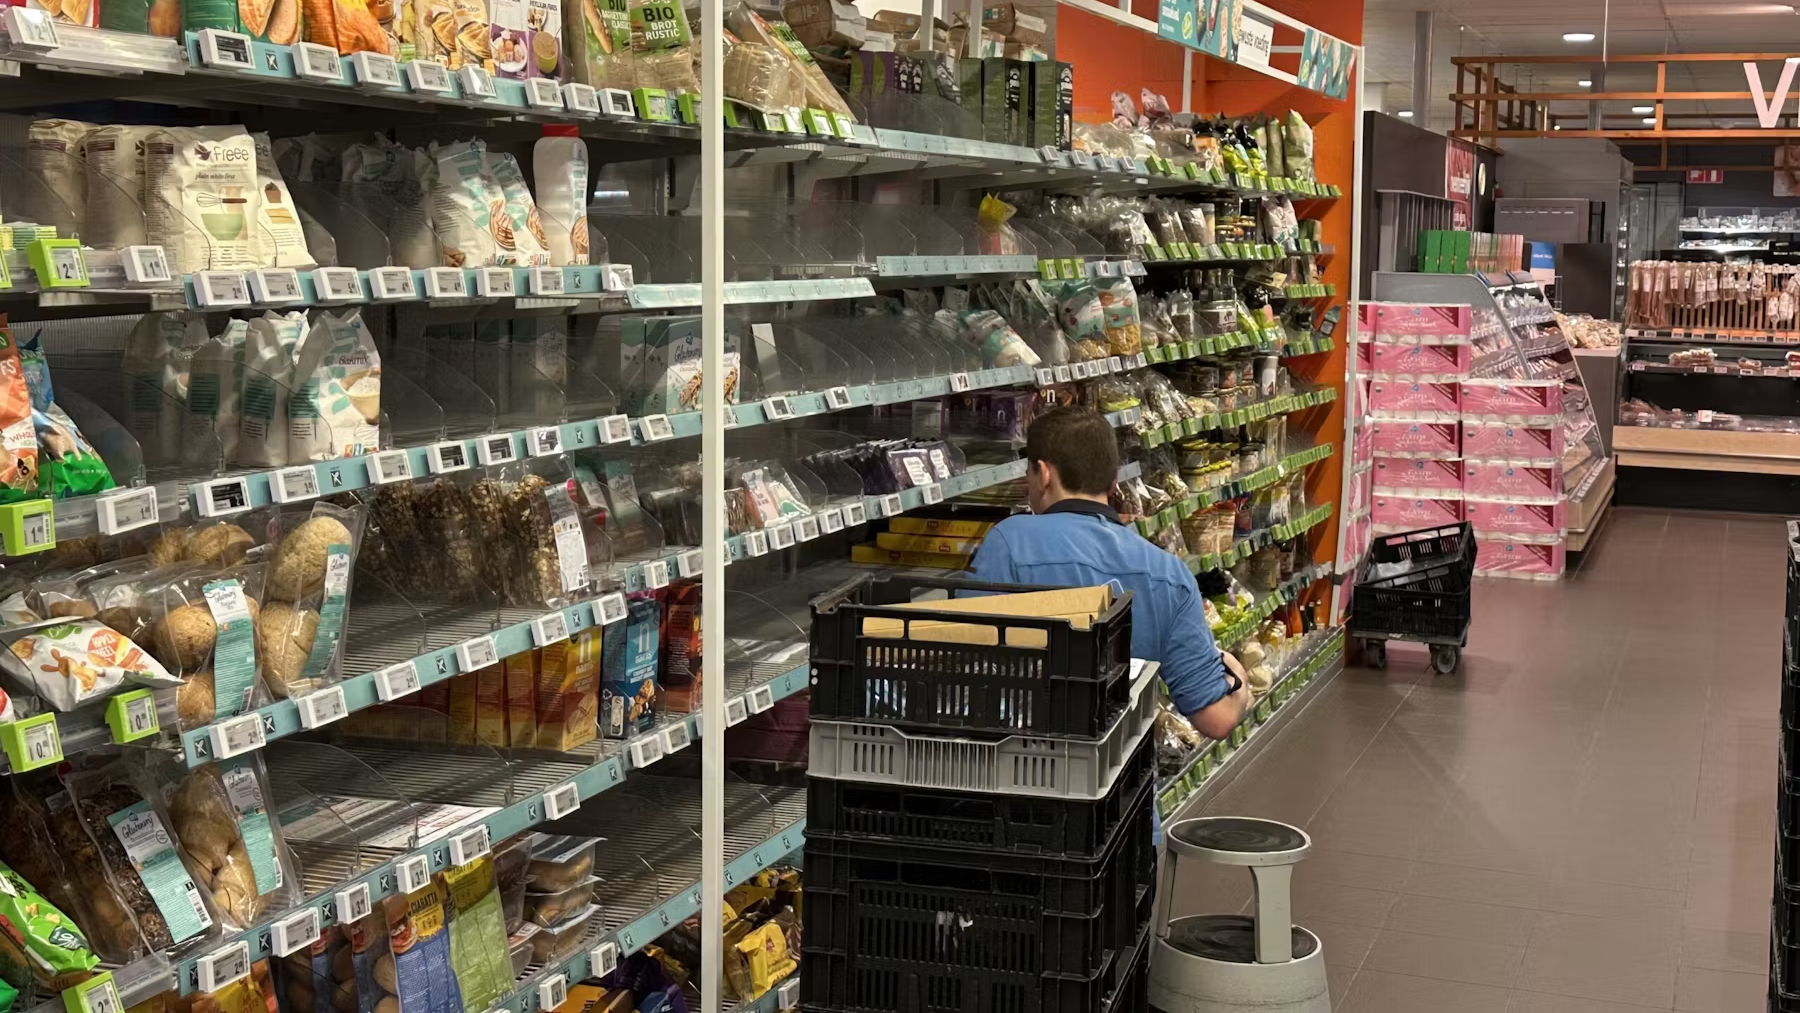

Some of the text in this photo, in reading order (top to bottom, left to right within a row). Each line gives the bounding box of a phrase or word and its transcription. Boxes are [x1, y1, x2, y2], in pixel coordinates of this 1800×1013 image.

[643, 7, 675, 22] BIO
[651, 20, 677, 31] BROT
[645, 29, 680, 41] RUSTIC
[1743, 62, 1800, 128] V
